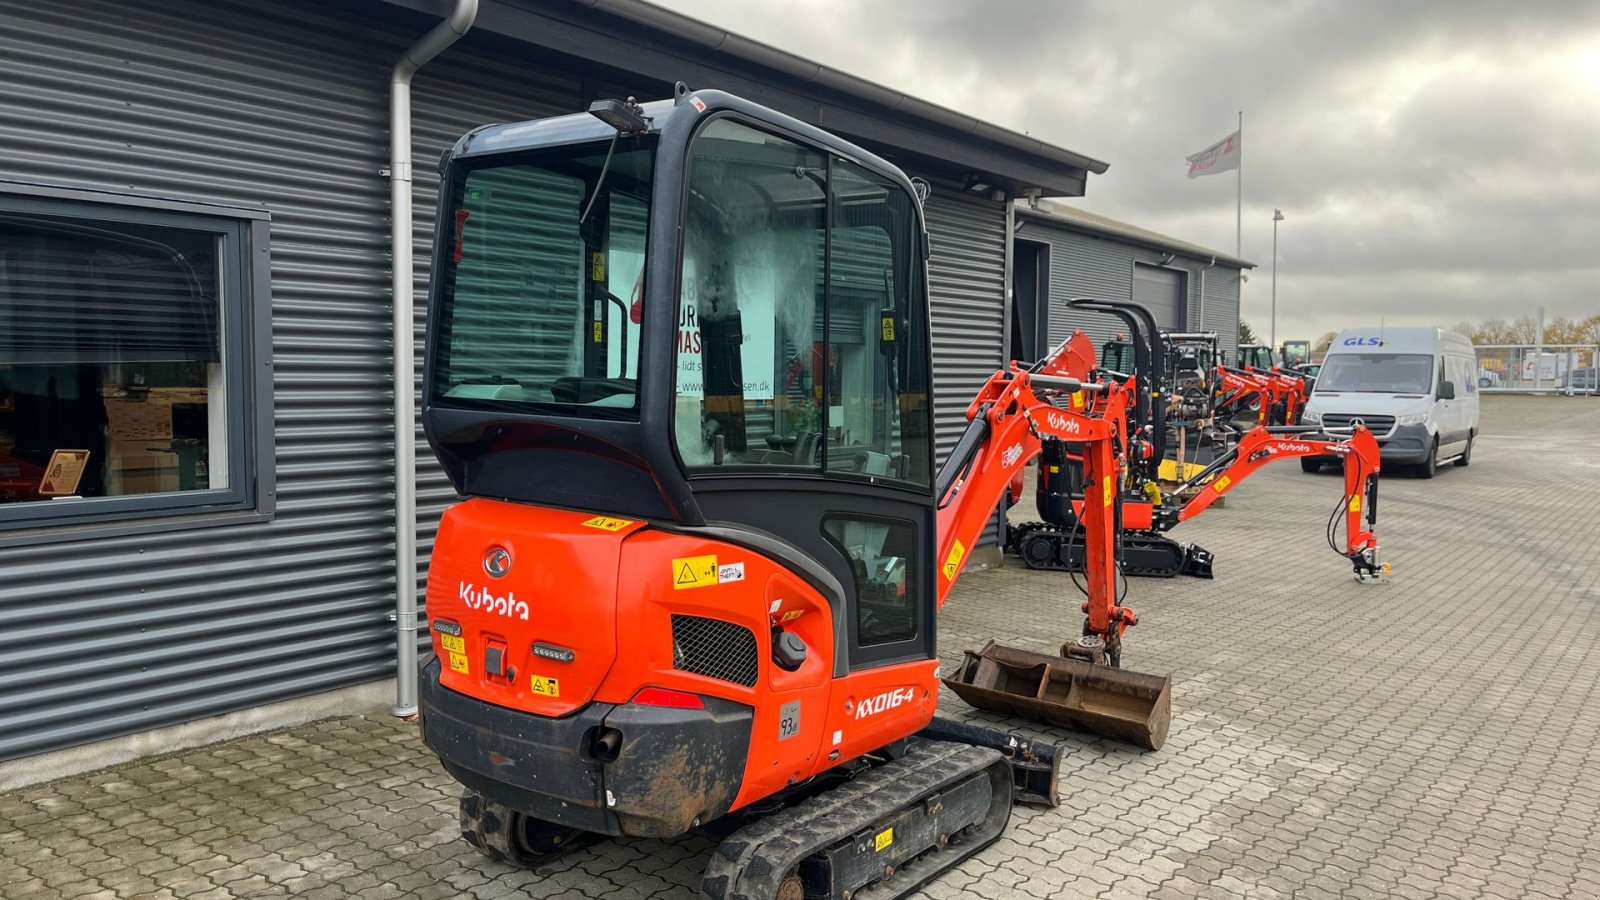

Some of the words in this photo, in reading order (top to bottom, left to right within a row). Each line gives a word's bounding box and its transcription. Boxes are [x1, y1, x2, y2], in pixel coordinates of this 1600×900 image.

[1343, 337, 1380, 346] GLS
[682, 360, 696, 371] lidt
[1047, 411, 1080, 435] Kubota
[1277, 442, 1310, 452] Kubota
[459, 581, 529, 620] Kubota
[781, 717, 793, 736] 93
